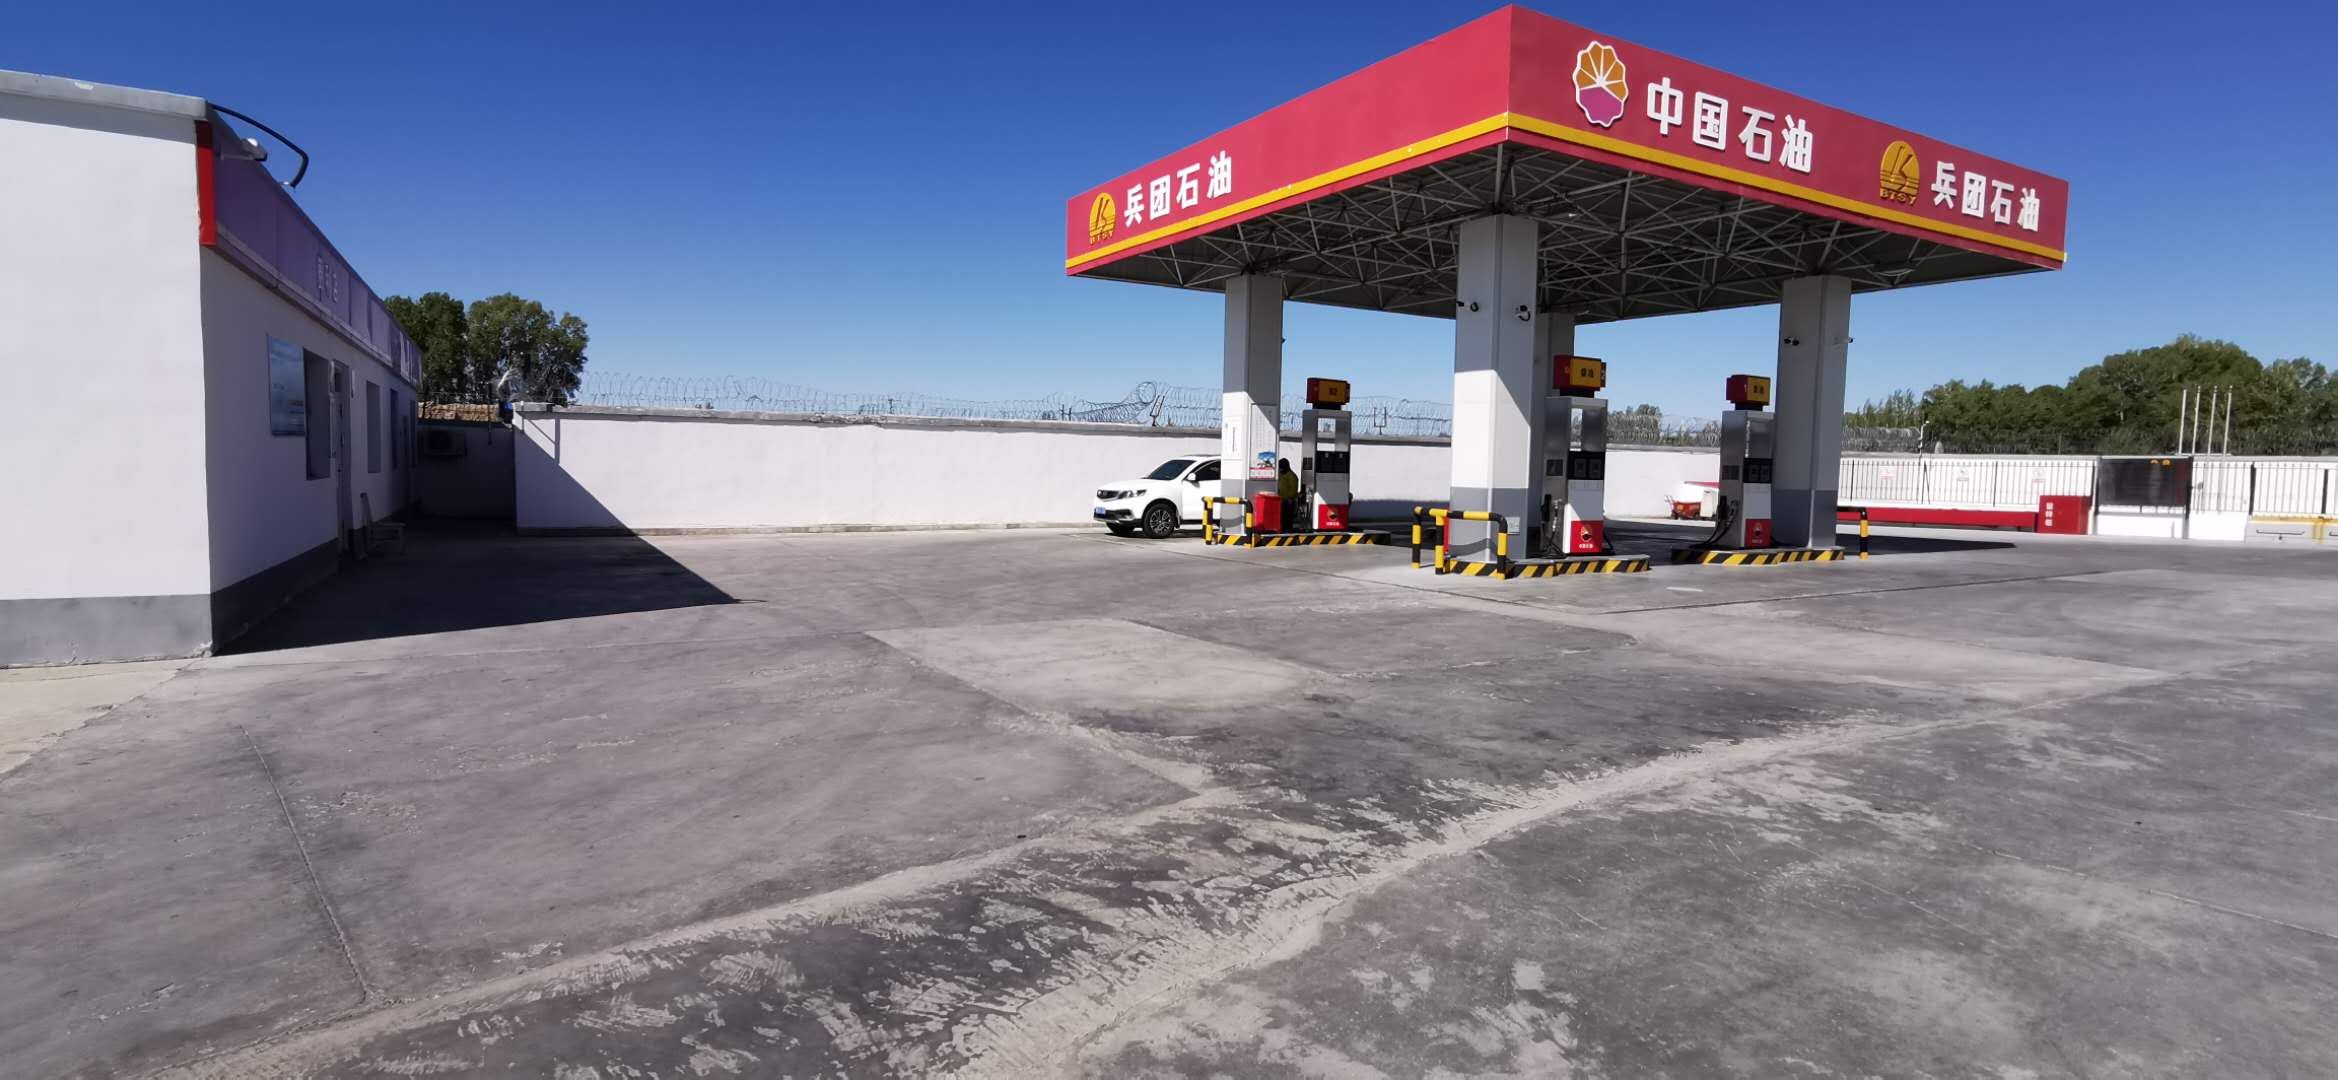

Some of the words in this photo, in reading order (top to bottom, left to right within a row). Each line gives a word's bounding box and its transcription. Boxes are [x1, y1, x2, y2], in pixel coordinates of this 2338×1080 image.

[1647, 77, 1813, 173] 中国石油
[1124, 150, 1232, 228] 兵团石油
[1931, 160, 2040, 232] 兵团石油
